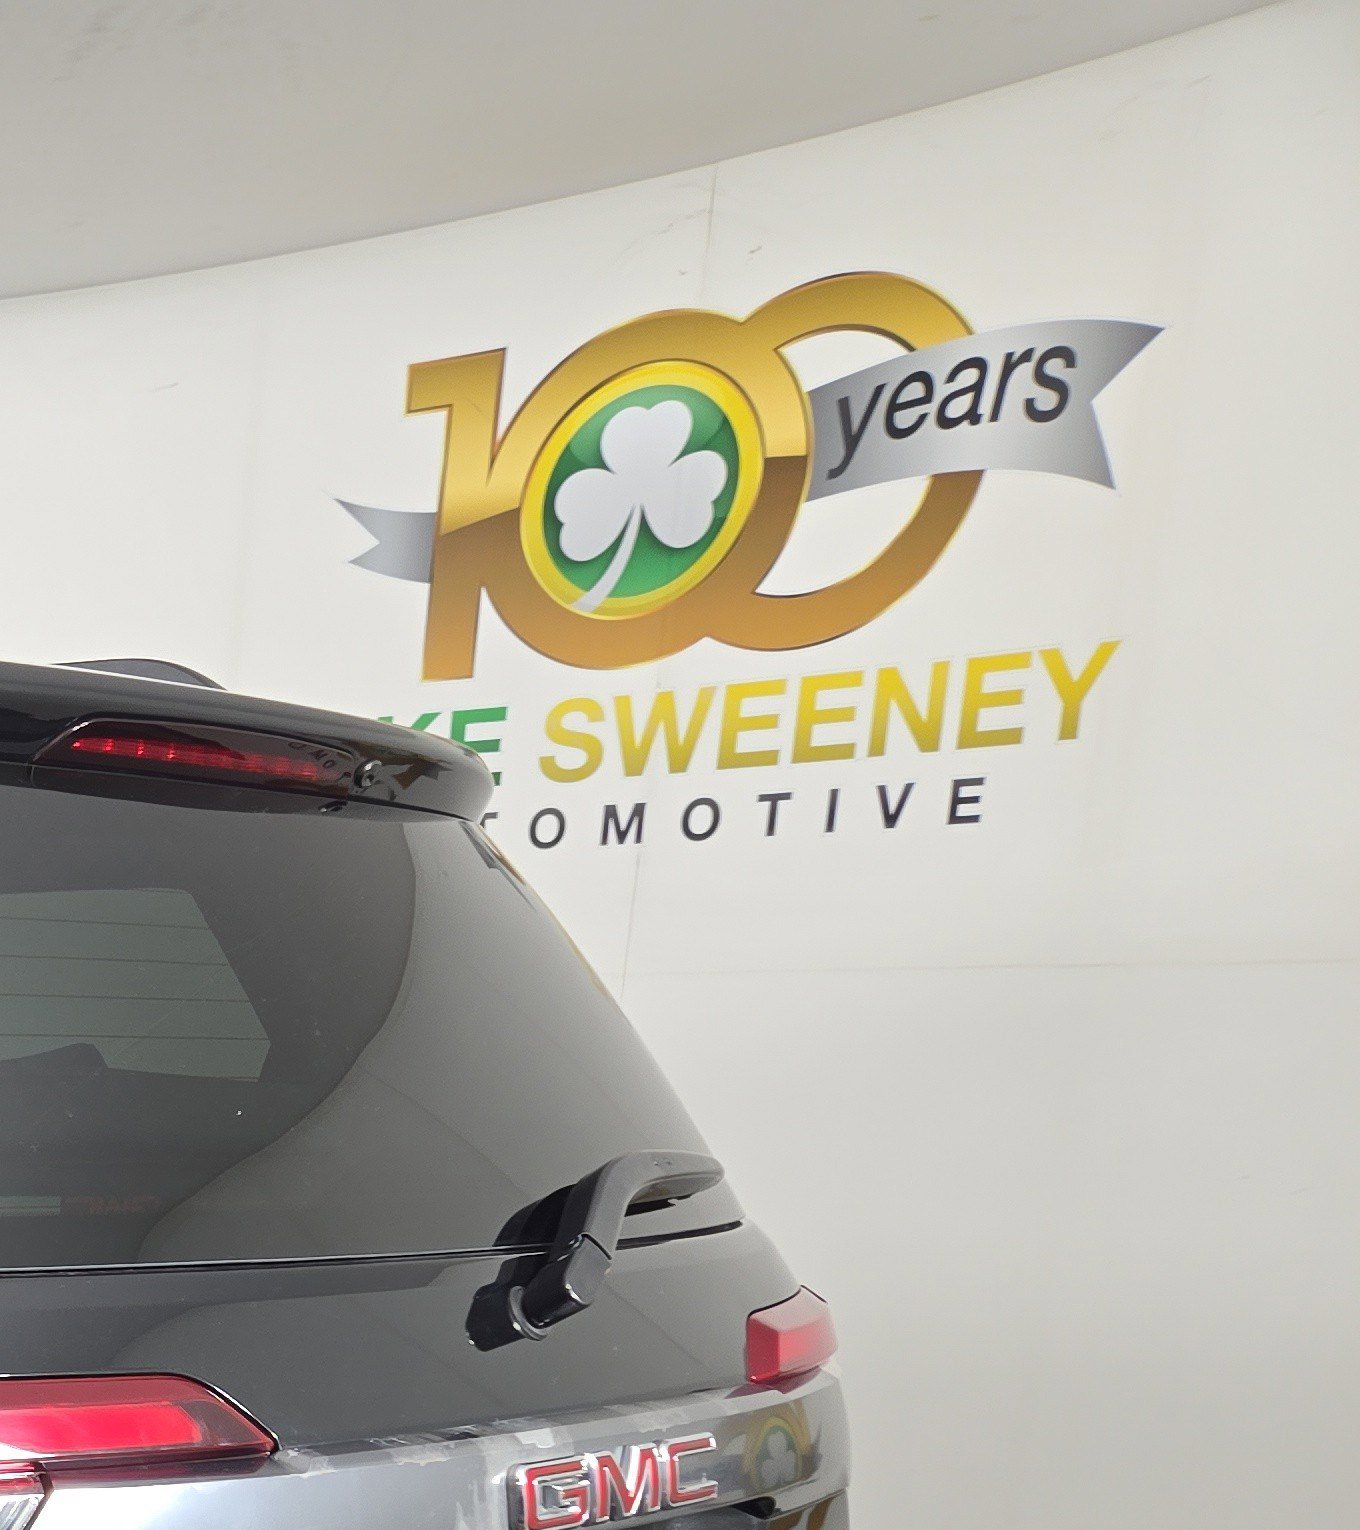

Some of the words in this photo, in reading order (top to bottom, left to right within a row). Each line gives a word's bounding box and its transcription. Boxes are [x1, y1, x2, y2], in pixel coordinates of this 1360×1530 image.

[826, 343, 1078, 481] years
[538, 639, 1121, 784] SWEENEY
[480, 776, 989, 850] OMOTIVE
